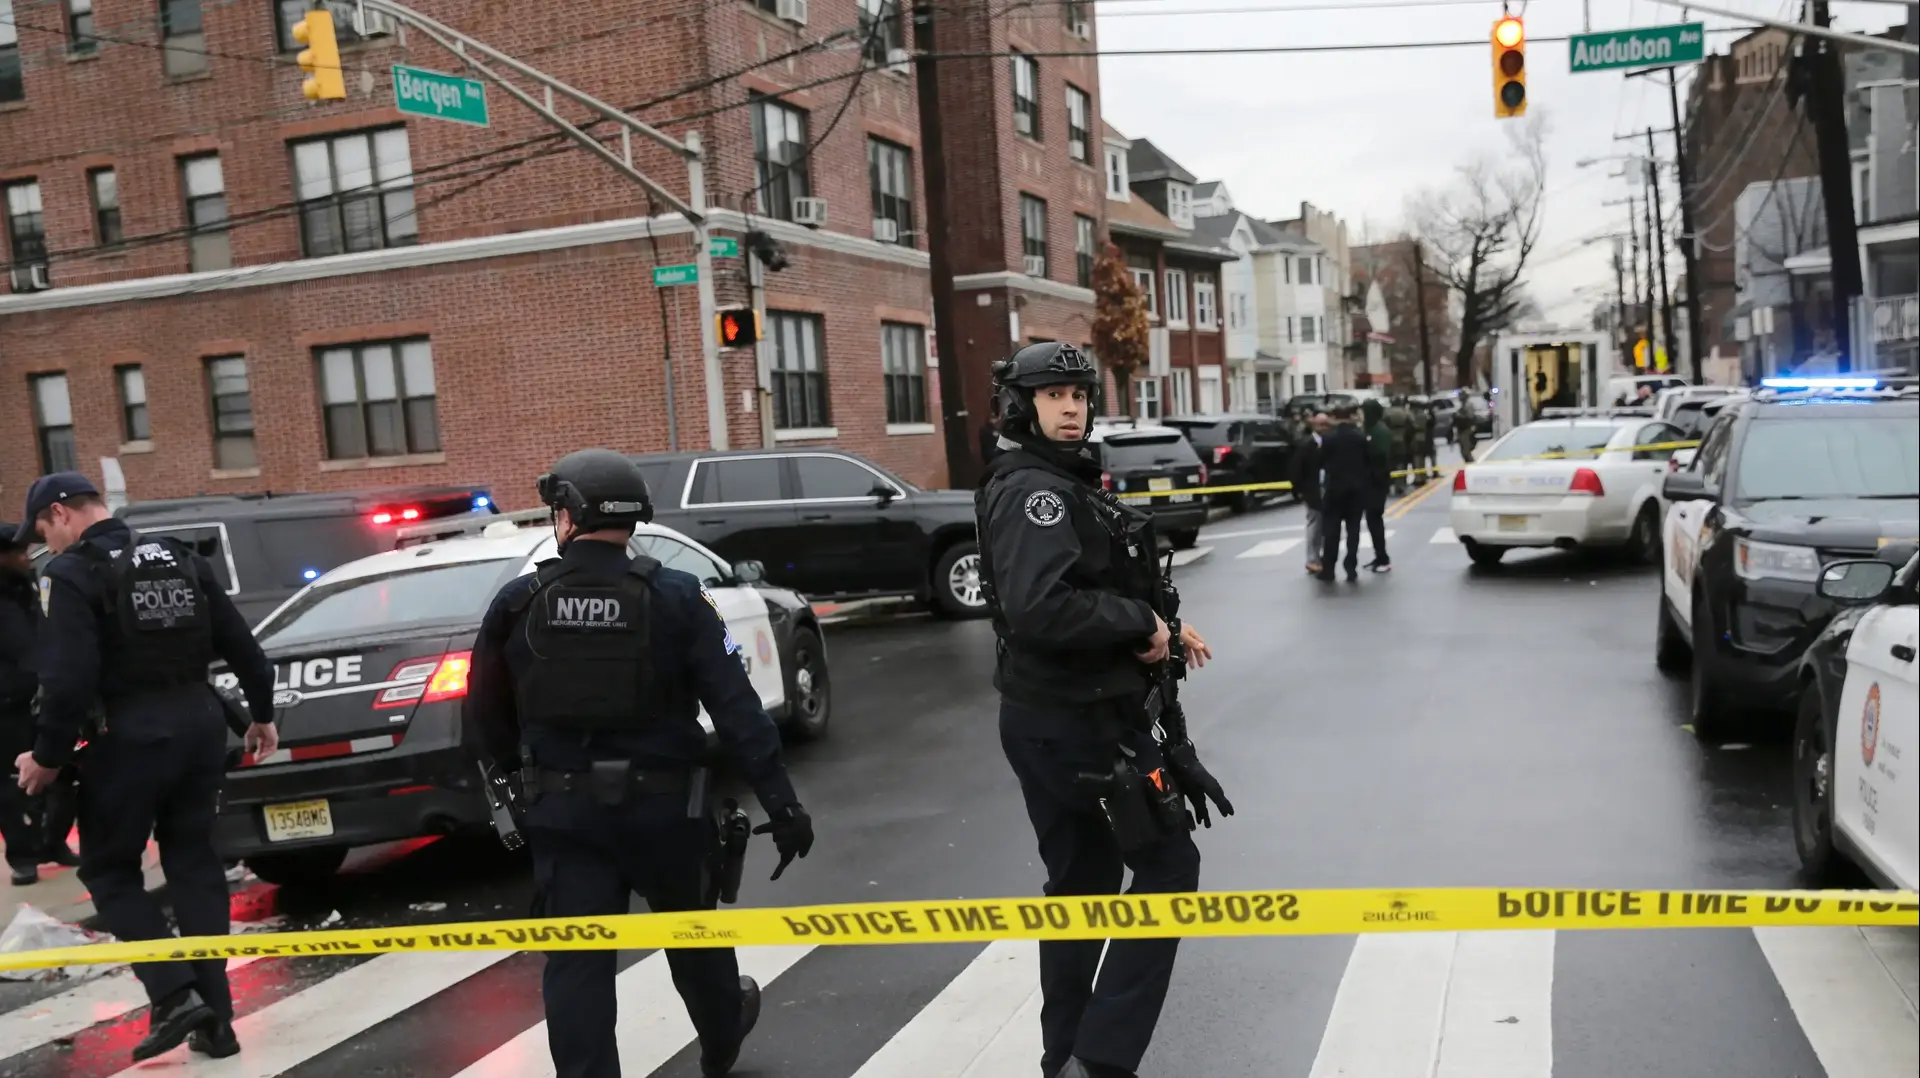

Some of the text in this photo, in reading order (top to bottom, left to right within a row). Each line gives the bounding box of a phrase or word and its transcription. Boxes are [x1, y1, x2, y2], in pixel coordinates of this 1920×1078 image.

[1573, 29, 1699, 67] Audubon Ave
[397, 69, 481, 114] Bergen Ave
[131, 588, 196, 610] POLICE
[556, 597, 620, 622] NYPD
[585, 620, 612, 628] SERVICE
